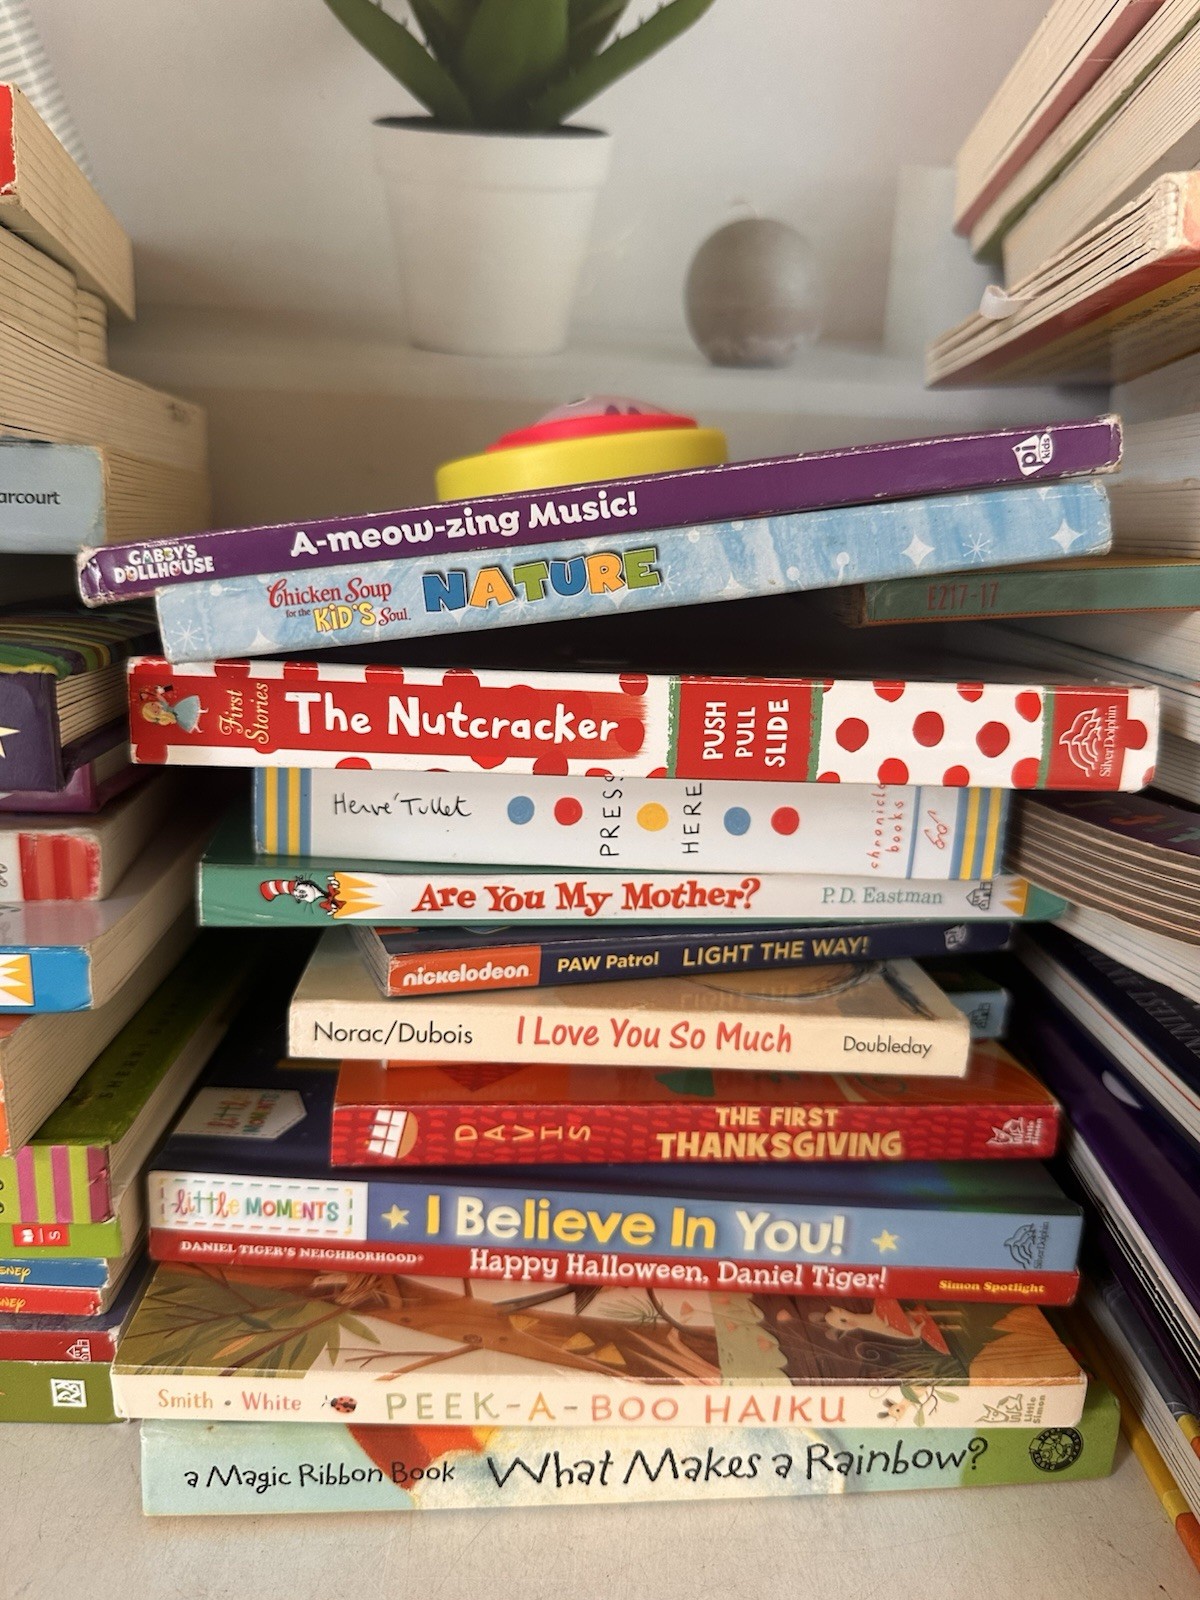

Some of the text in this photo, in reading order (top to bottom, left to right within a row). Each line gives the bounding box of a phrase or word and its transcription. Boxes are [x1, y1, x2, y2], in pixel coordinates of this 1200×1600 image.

[1041, 437, 1051, 459] kids
[290, 490, 638, 558] A-meow-zing Music!
[113, 556, 215, 584] DOLLHOUSE
[128, 544, 198, 565] GABBY'S
[267, 577, 392, 608] Chicken Soup
[421, 547, 661, 614] NATURE
[286, 609, 297, 618] for
[298, 608, 311, 617] the
[218, 688, 245, 737] First
[244, 681, 271, 745] Stories
[285, 691, 619, 744] The Nutcracker
[703, 701, 727, 760] PUSH
[735, 706, 756, 758] PULL
[764, 698, 789, 768] SLIDE
[400, 796, 472, 817] Tullet
[682, 783, 703, 854] HERE
[885, 800, 904, 853] books
[411, 877, 762, 917] Are You My Mother?
[863, 887, 943, 905] Eastman
[557, 936, 870, 973] PAW Patrol LIGHT THE WAY!
[402, 962, 530, 988] nickelodeon
[313, 1016, 792, 1054] Norac/Dubois I Love You So Much
[843, 1034, 933, 1059] Doubleday
[454, 1123, 592, 1142] DAVIS
[715, 1107, 840, 1127] THE FIRST
[656, 1130, 902, 1160] THANKSGIVING
[171, 1188, 340, 1223] little MOMENTS
[426, 1195, 846, 1257] I Believe In You!
[180, 1240, 237, 1253] DANIEL
[239, 1244, 297, 1257] TIGER'S
[469, 1247, 888, 1290] Happy Halloween, Daniel Tiger!
[938, 1279, 1045, 1295] Simon Spotlight
[158, 1388, 302, 1412] Smith White
[386, 1390, 847, 1425] PEEK-A-BOO HAIKU
[1023, 1396, 1037, 1422] Little
[1032, 1394, 1046, 1424] Simon
[184, 1460, 457, 1494] a Magic Ribbon Book
[486, 1449, 614, 1488] What
[623, 1447, 762, 1485] Makes
[771, 1451, 794, 1479] a
[805, 1436, 988, 1480] Rainbow?
